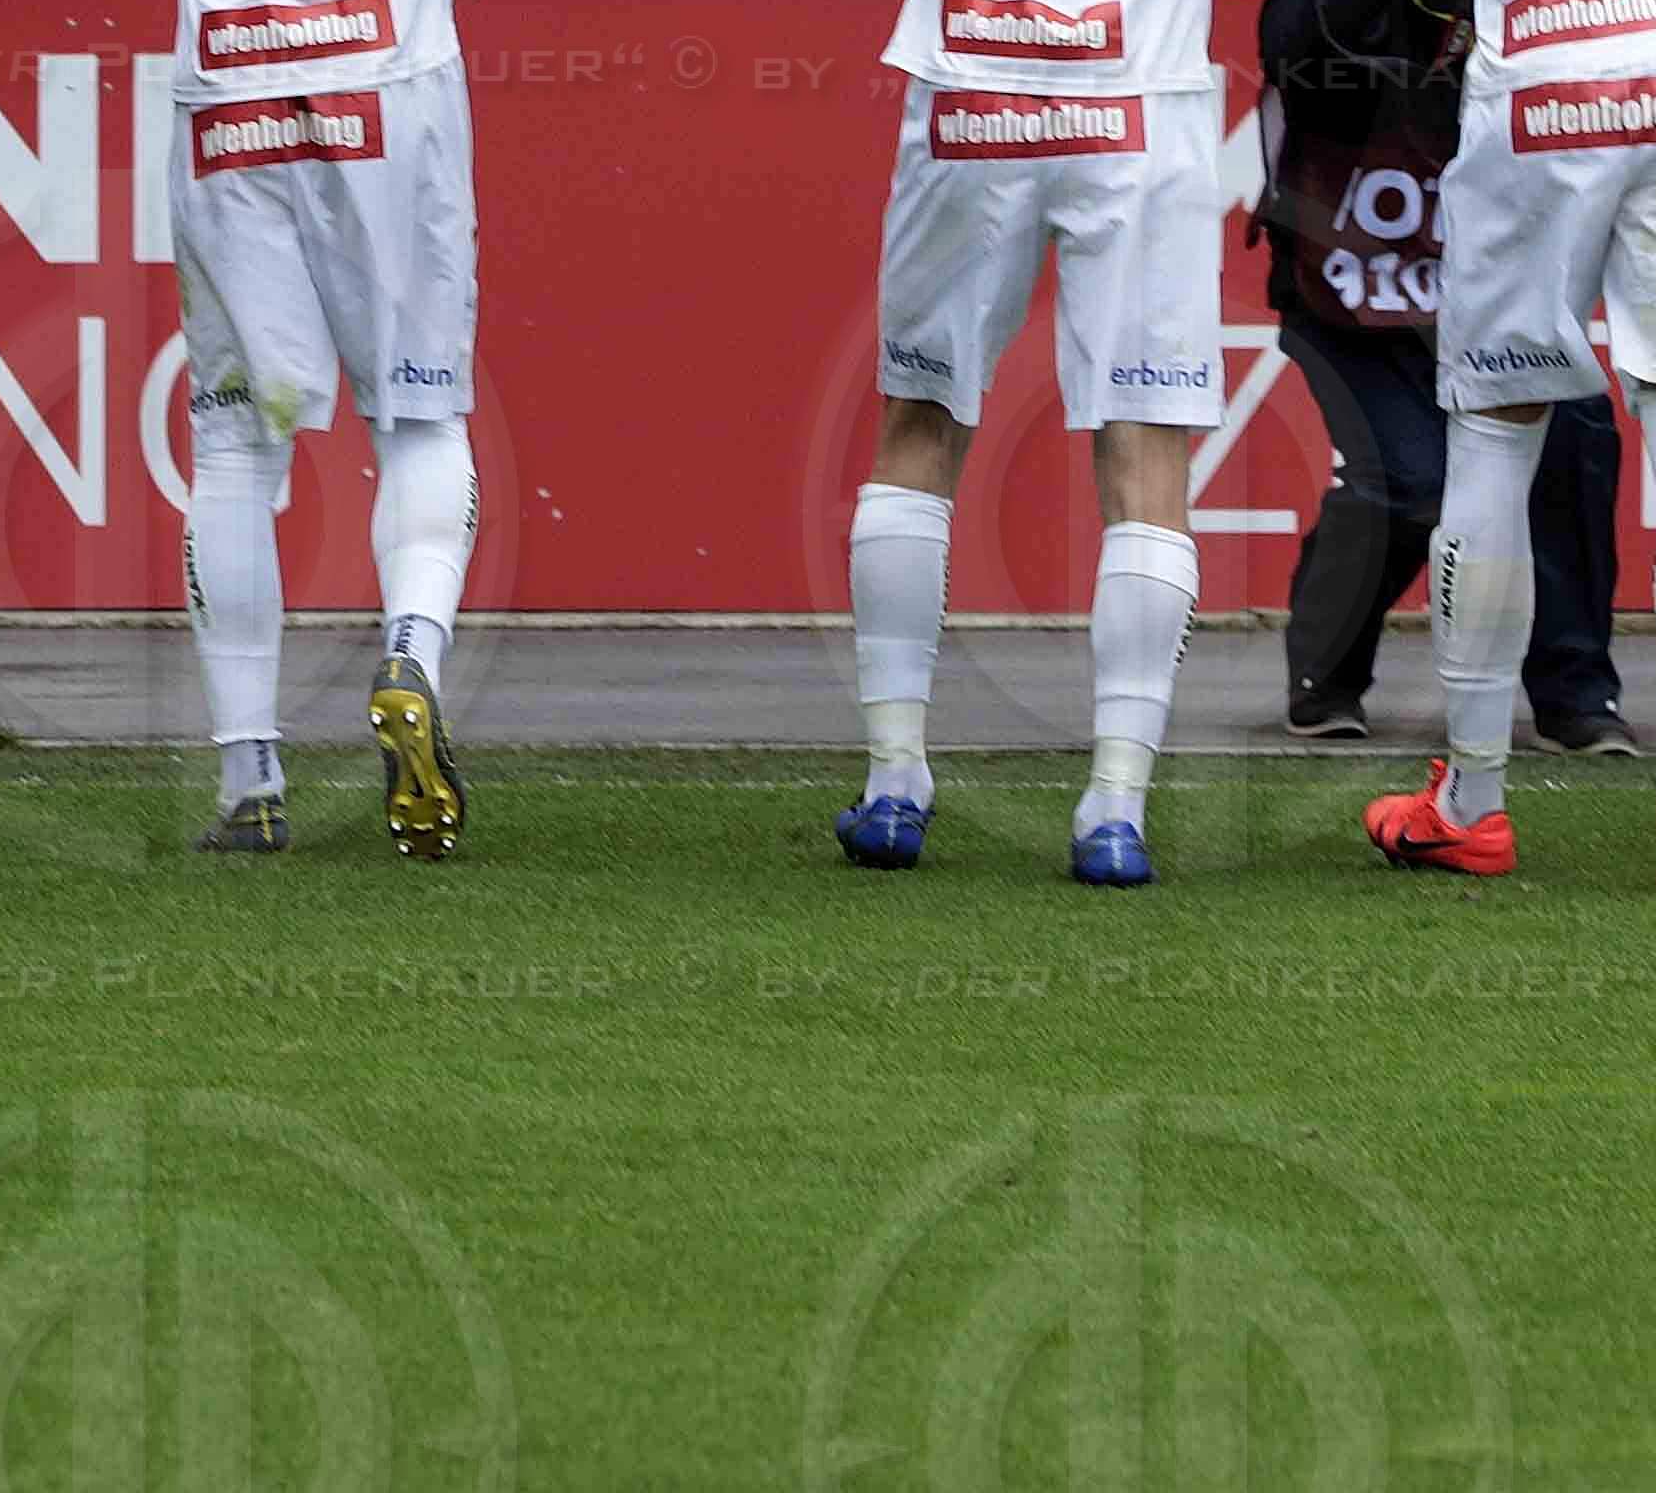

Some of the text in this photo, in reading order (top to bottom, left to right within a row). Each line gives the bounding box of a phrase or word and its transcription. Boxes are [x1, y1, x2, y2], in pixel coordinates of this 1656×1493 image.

[207, 11, 380, 57] wienholding
[937, 103, 1126, 144] wienholding
[1107, 361, 1208, 391] erbund
[1463, 348, 1572, 374] Verbund
